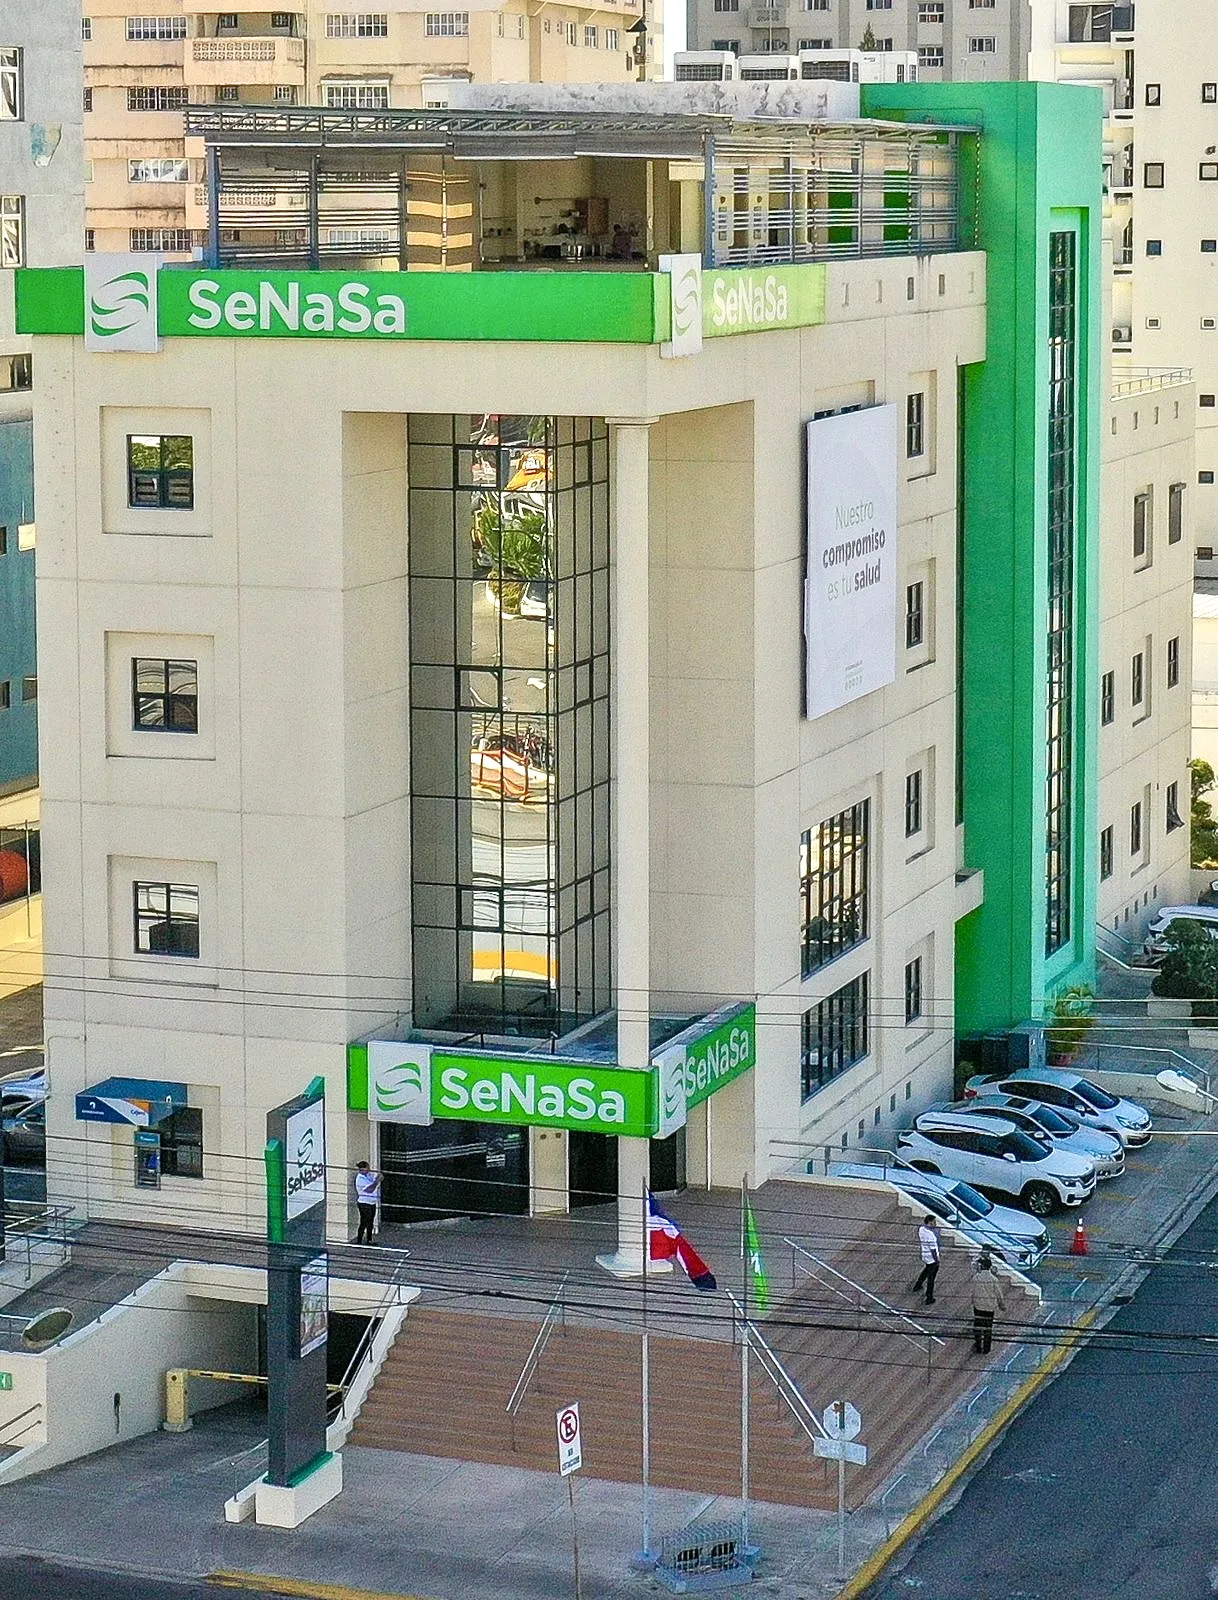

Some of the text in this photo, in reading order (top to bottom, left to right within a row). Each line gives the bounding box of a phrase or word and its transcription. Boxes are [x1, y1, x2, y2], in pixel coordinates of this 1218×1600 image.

[187, 279, 406, 334] SeNaSa
[713, 275, 788, 327] SeNaSa
[835, 500, 874, 530] Nuestro
[822, 527, 886, 569] compromiso
[827, 581, 840, 602] es
[854, 558, 881, 592] salud
[685, 1027, 749, 1098] SeNaSa
[440, 1067, 625, 1123] SeNaSa
[287, 1162, 324, 1196] SeNaSa
